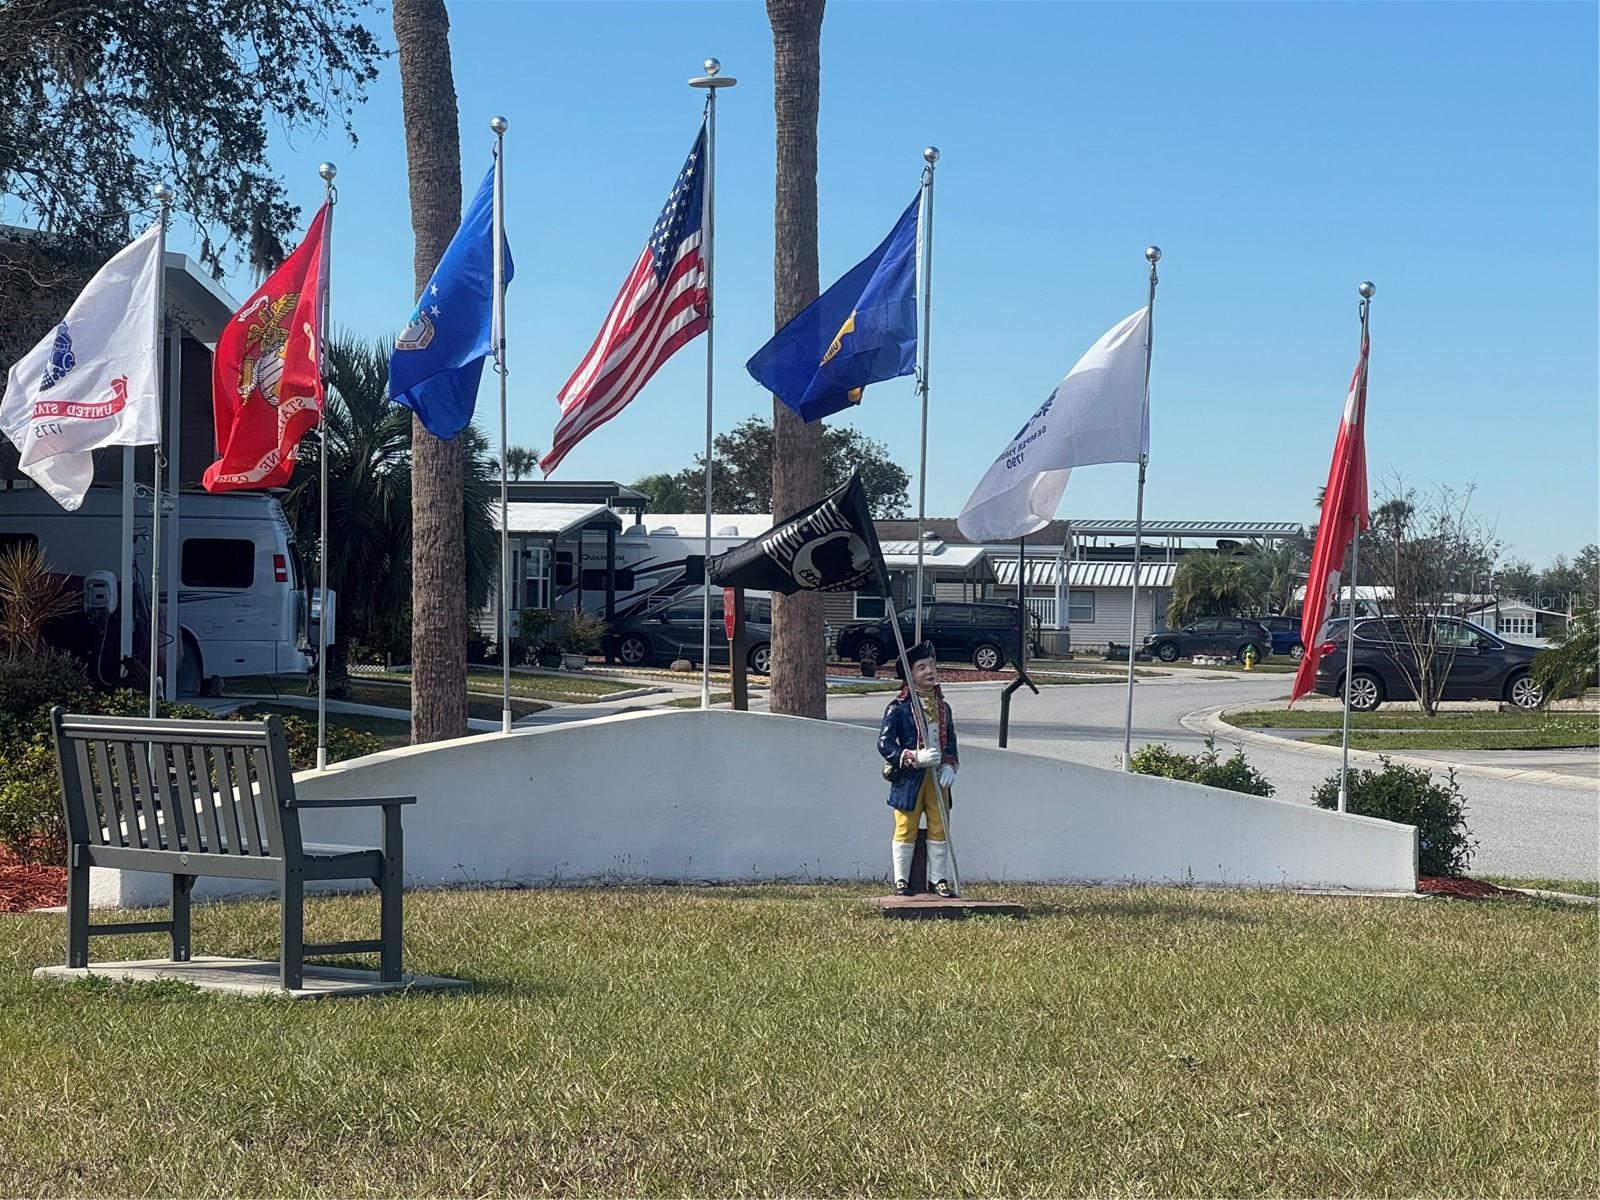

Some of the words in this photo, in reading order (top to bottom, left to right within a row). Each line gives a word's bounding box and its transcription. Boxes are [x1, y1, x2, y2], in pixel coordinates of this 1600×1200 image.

[581, 553, 625, 561] QUANUM
[761, 522, 805, 577] POW
[806, 498, 855, 535] MIA
